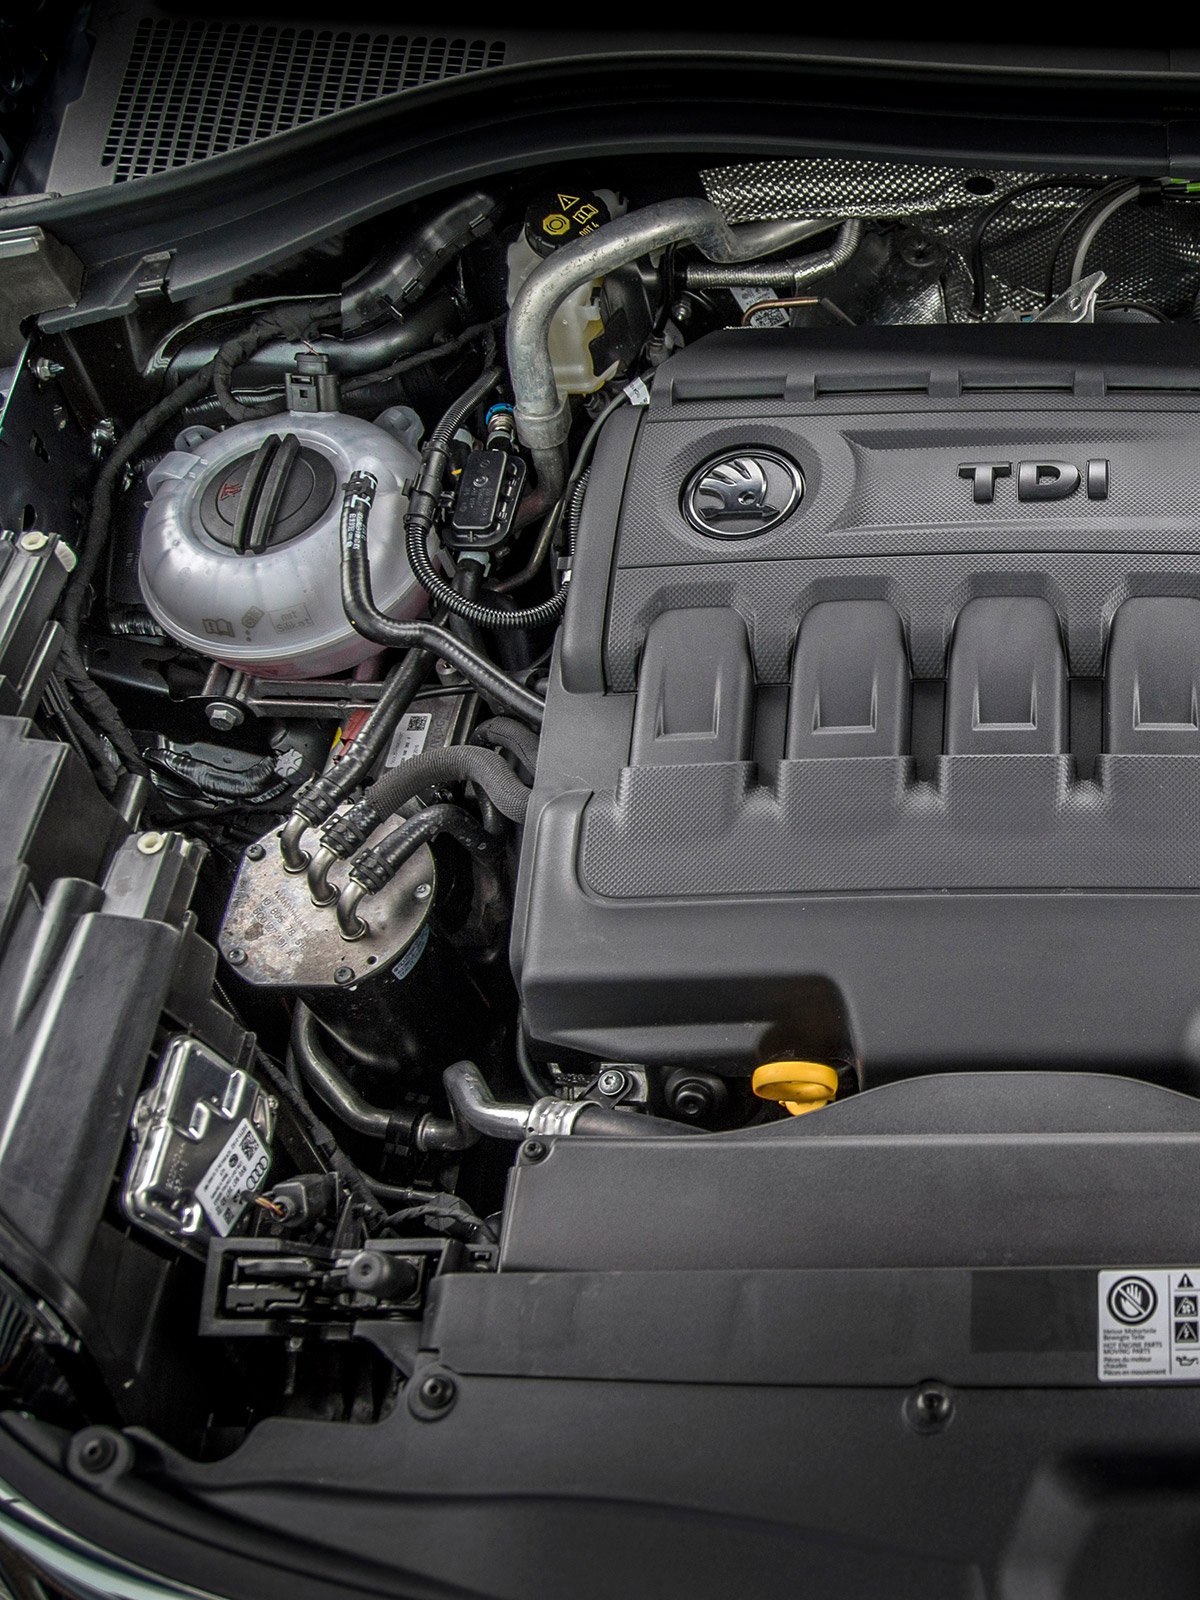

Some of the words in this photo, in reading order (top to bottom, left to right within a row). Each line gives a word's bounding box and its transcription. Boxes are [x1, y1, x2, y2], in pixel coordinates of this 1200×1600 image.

[957, 458, 1111, 503] TDI
[281, 609, 298, 621] mit
[275, 618, 313, 633] Silikat
